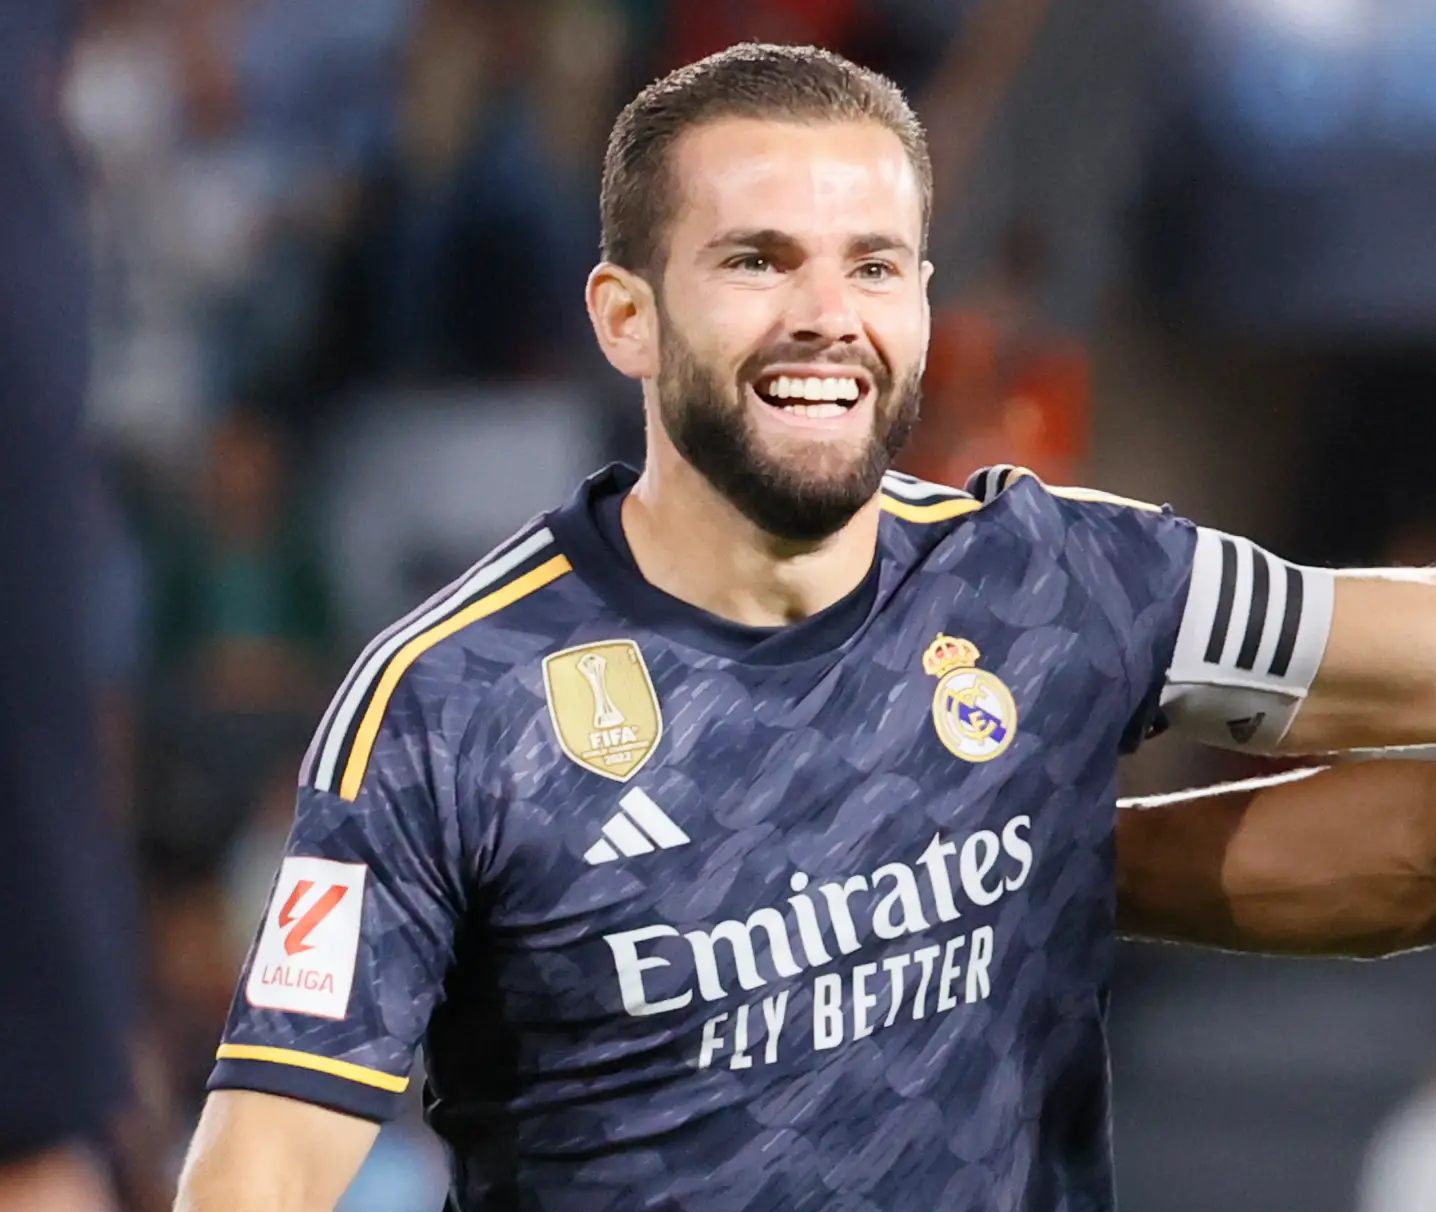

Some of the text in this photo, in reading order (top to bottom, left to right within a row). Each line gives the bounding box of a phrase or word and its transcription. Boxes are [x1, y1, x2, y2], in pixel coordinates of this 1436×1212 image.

[589, 726, 637, 749] FIFA
[602, 815, 1034, 1016] Emirates
[262, 963, 334, 994] LALIGA
[698, 924, 994, 1070] FLY BETTER
